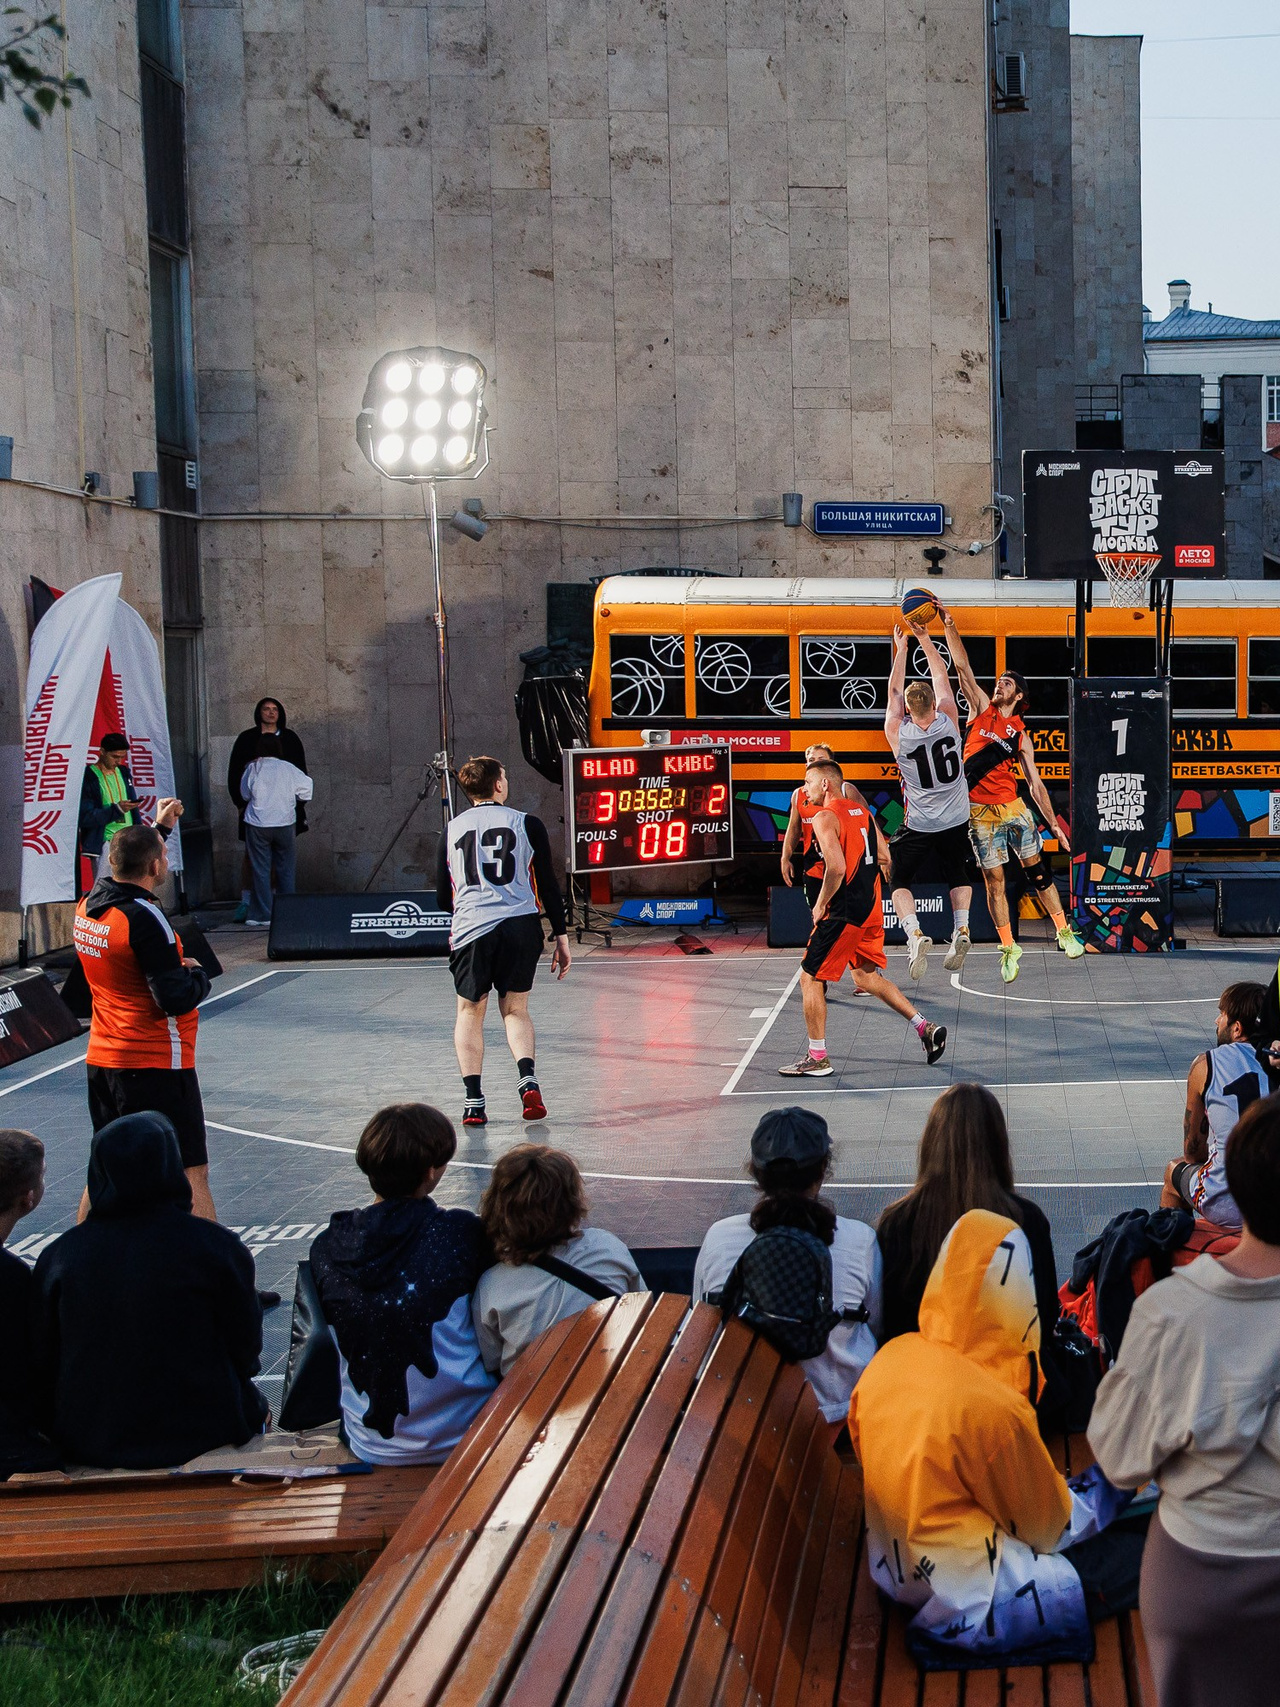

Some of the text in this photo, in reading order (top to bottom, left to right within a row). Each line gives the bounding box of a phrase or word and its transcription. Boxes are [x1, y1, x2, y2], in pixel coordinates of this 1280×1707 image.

[1091, 468, 1158, 496] СТРИТ
[821, 511, 937, 522] БОЛЬШАЯ НИКИТСКАЯ
[1089, 494, 1162, 520] БАСКЕТ
[1091, 514, 1159, 537] ТУР
[1092, 533, 1159, 553] МОСКВА
[1179, 549, 1211, 558] ЛЕТО
[729, 737, 781, 746] МОСКВЕ
[1112, 718, 1129, 756] 1
[1173, 729, 1234, 752] СКВА
[129, 734, 156, 788] СПОРТ
[583, 759, 636, 777] BLAD
[664, 755, 715, 773] КИВС
[907, 735, 960, 789] 16
[38, 742, 72, 802] СПОРТ
[639, 776, 670, 789] TIME
[1097, 773, 1145, 794] СТРИТ
[597, 791, 615, 822] 3
[708, 785, 725, 814] 2
[1096, 790, 1148, 810] БАСКЕТ
[636, 810, 674, 824] SHOT
[1097, 805, 1145, 821] ТУР
[691, 822, 729, 834] FOULS
[1098, 818, 1145, 832] МОСКВА
[577, 830, 617, 843] FOULS
[640, 822, 686, 858] 08
[860, 827, 874, 865] 1
[454, 827, 517, 887] 13
[596, 843, 602, 861] 1
[655, 910, 676, 919] СПОРТ
[656, 900, 698, 911] МОСКОВСКИЙ
[75, 915, 111, 936] ЕДЕРАЦИЯ
[351, 916, 452, 929] STREETBASKET
[73, 929, 109, 949] АСКЕТБОЛА
